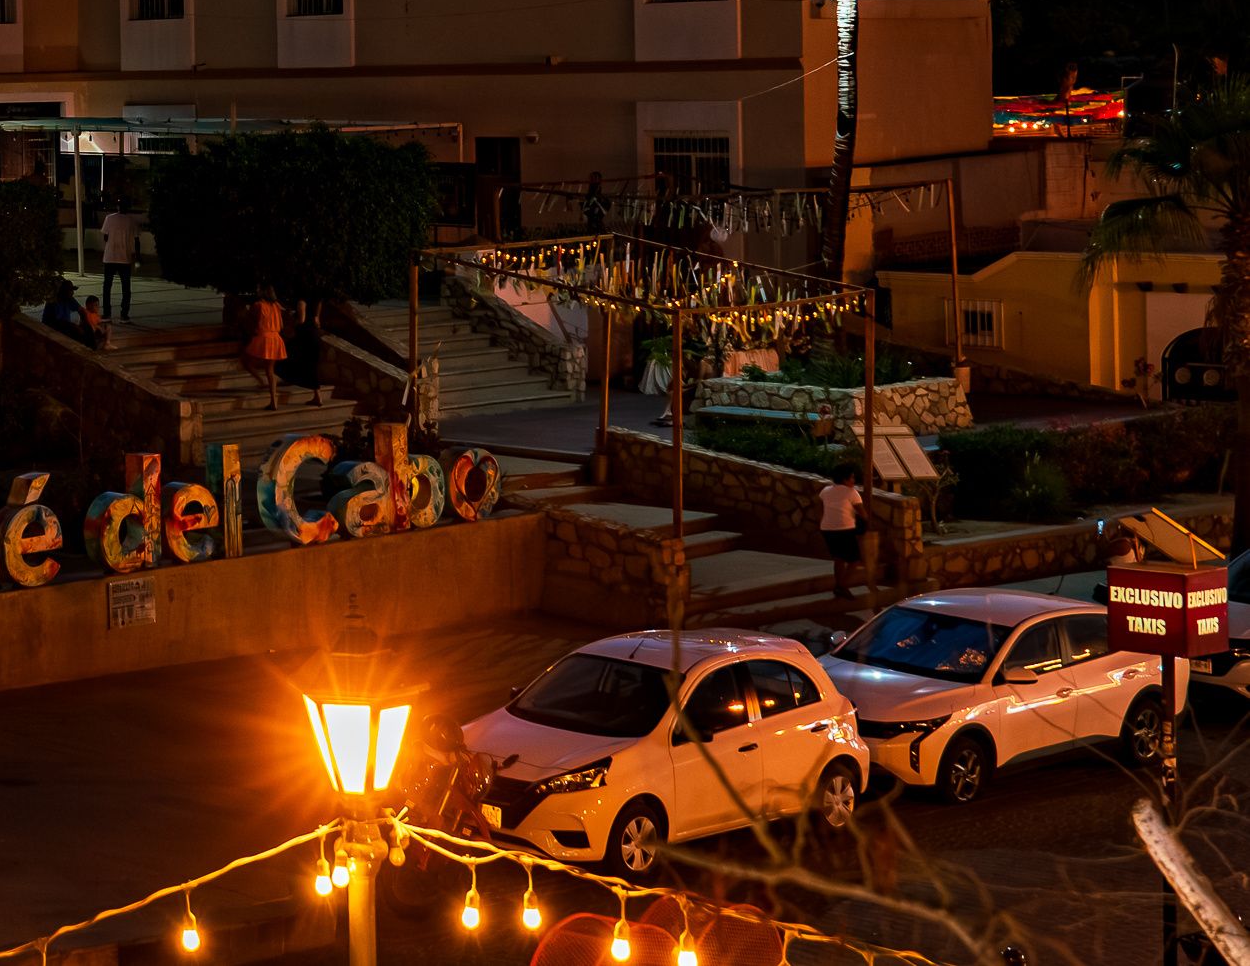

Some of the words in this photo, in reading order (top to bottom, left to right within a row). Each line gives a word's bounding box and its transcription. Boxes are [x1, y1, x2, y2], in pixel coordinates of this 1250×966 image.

[84, 443, 243, 574] del
[257, 423, 502, 545] Cabo
[1110, 586, 1184, 609] EXCLUSIVO
[1187, 587, 1228, 609] EXCLUSIVO
[1126, 615, 1167, 636] TAXIS
[1196, 616, 1220, 636] TAXIS
